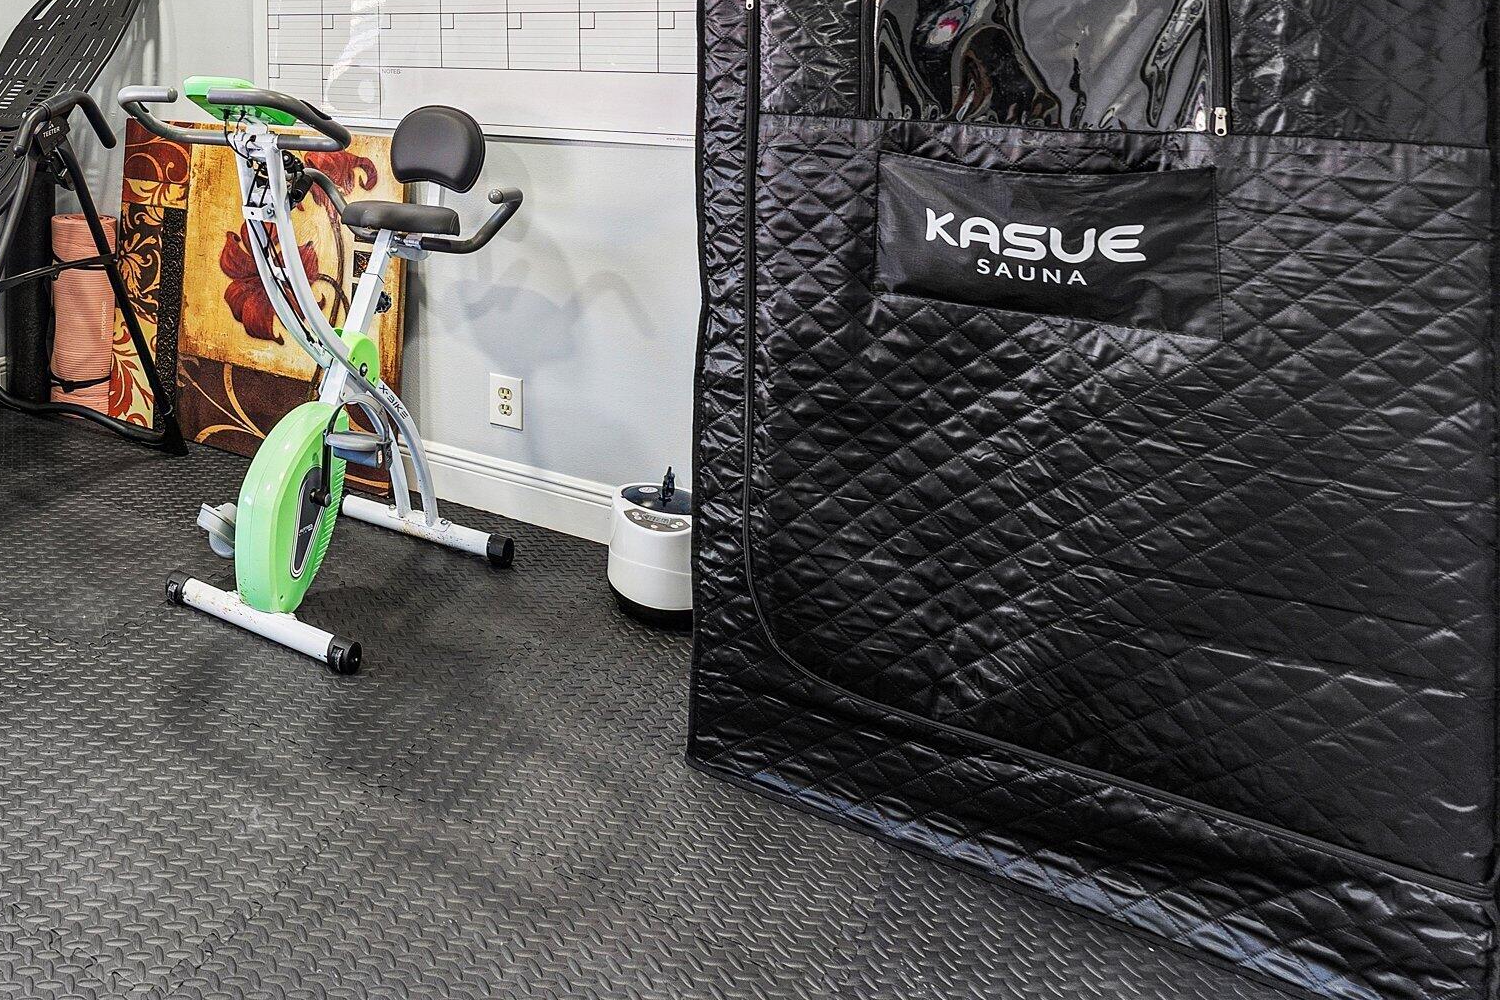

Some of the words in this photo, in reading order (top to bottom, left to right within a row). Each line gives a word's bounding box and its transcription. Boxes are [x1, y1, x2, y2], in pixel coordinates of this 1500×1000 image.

[43, 126, 60, 138] TEETER
[926, 208, 1146, 264] KASUE
[976, 258, 1088, 286] SAUNA
[379, 384, 408, 420] X-BIKE
